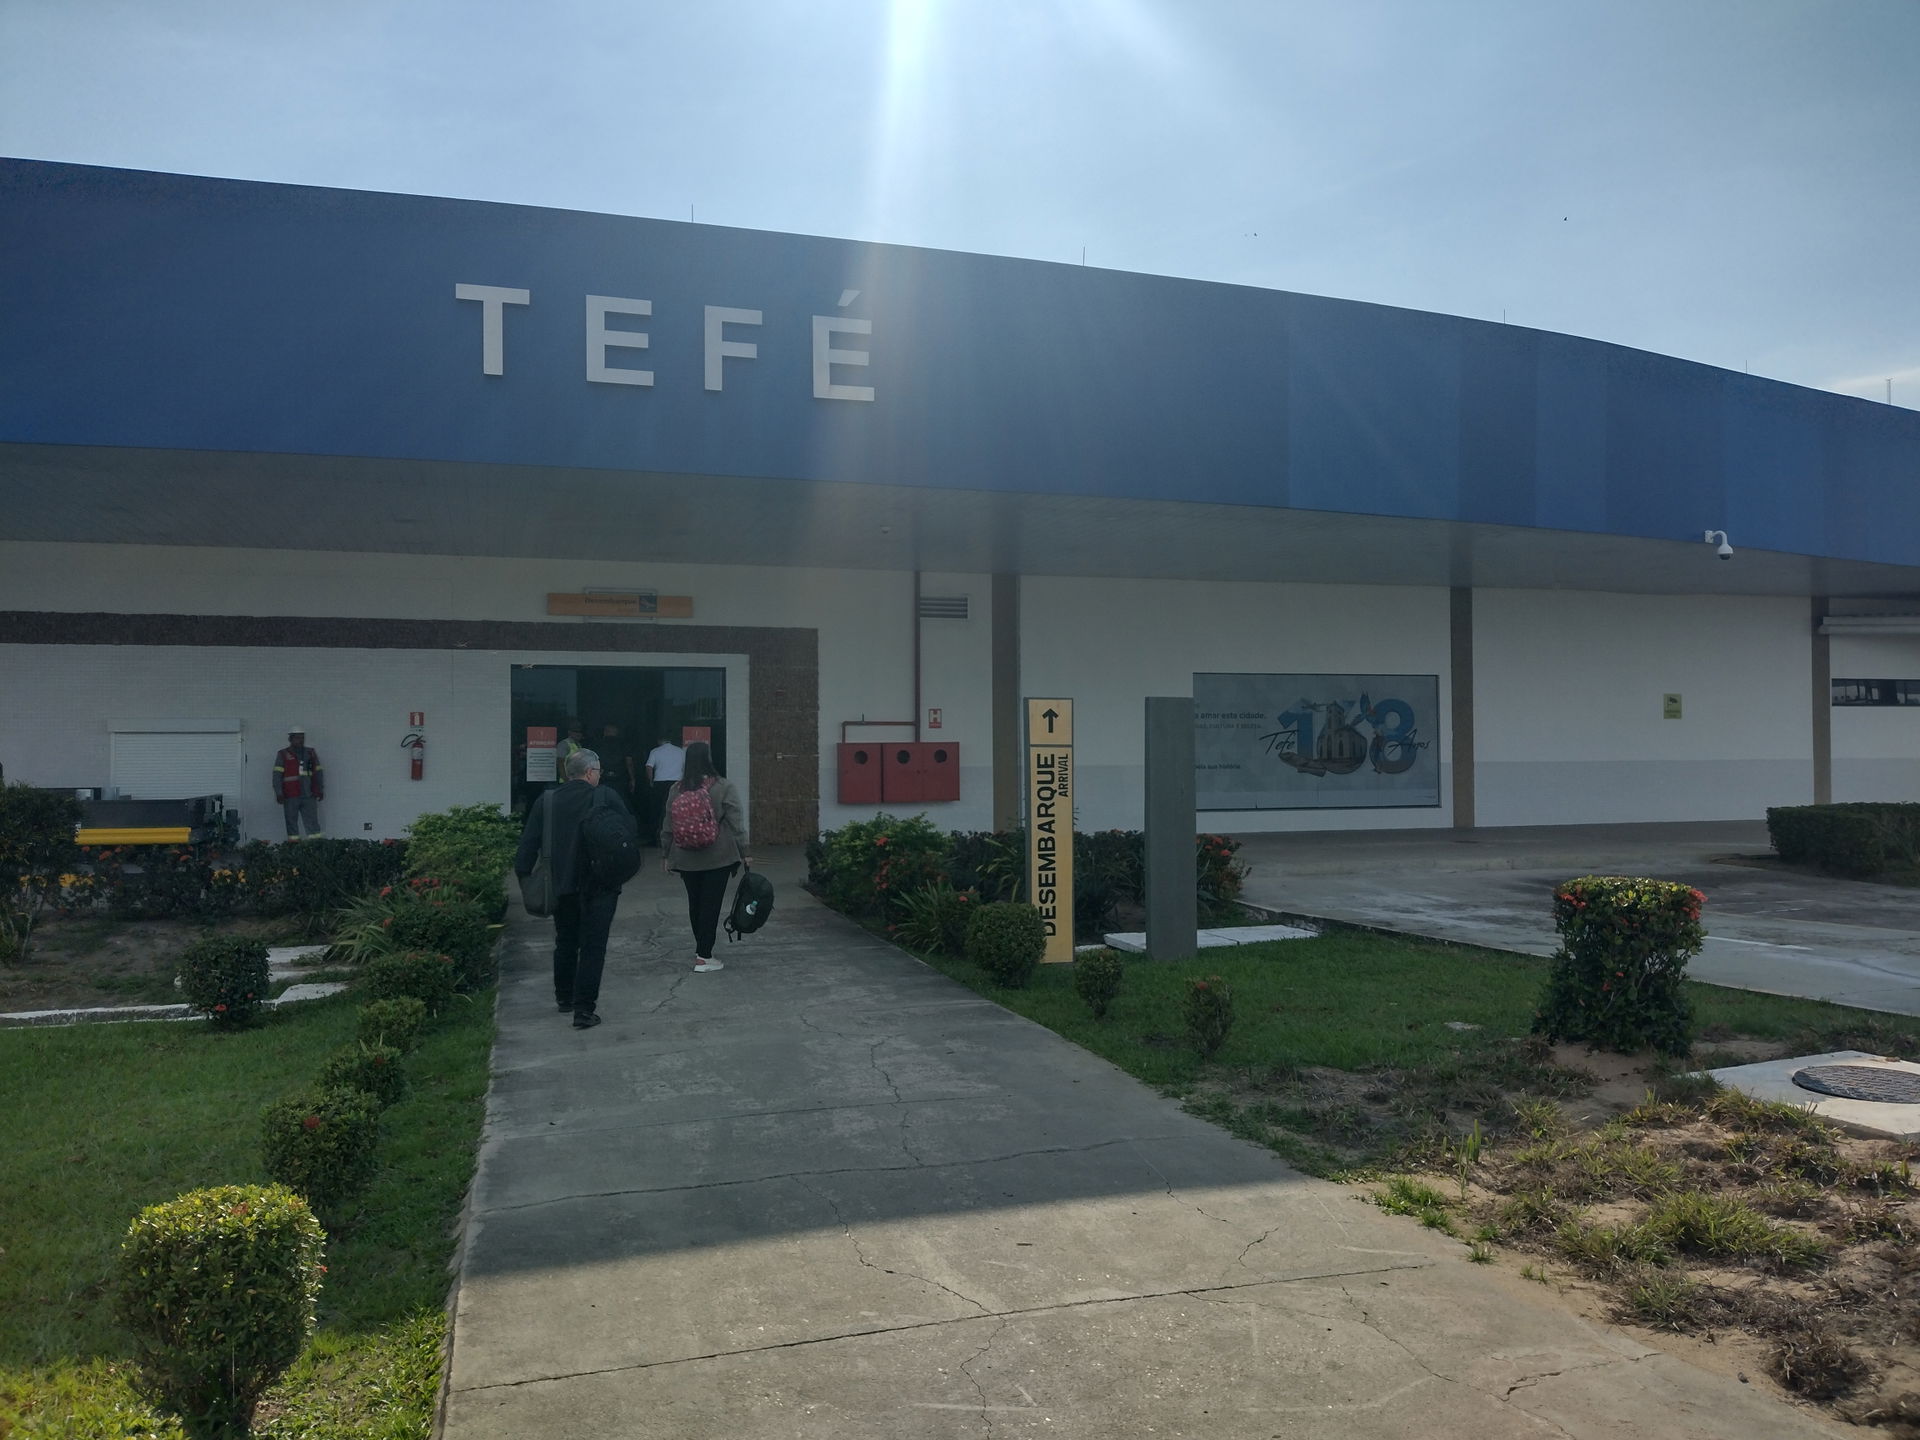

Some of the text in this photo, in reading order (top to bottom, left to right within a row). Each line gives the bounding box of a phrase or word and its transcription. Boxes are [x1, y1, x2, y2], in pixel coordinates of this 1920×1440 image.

[455, 283, 875, 402] TEFÉ
[1058, 753, 1069, 797] ARRIVAL
[1036, 753, 1057, 936] DESEMBARQUE
